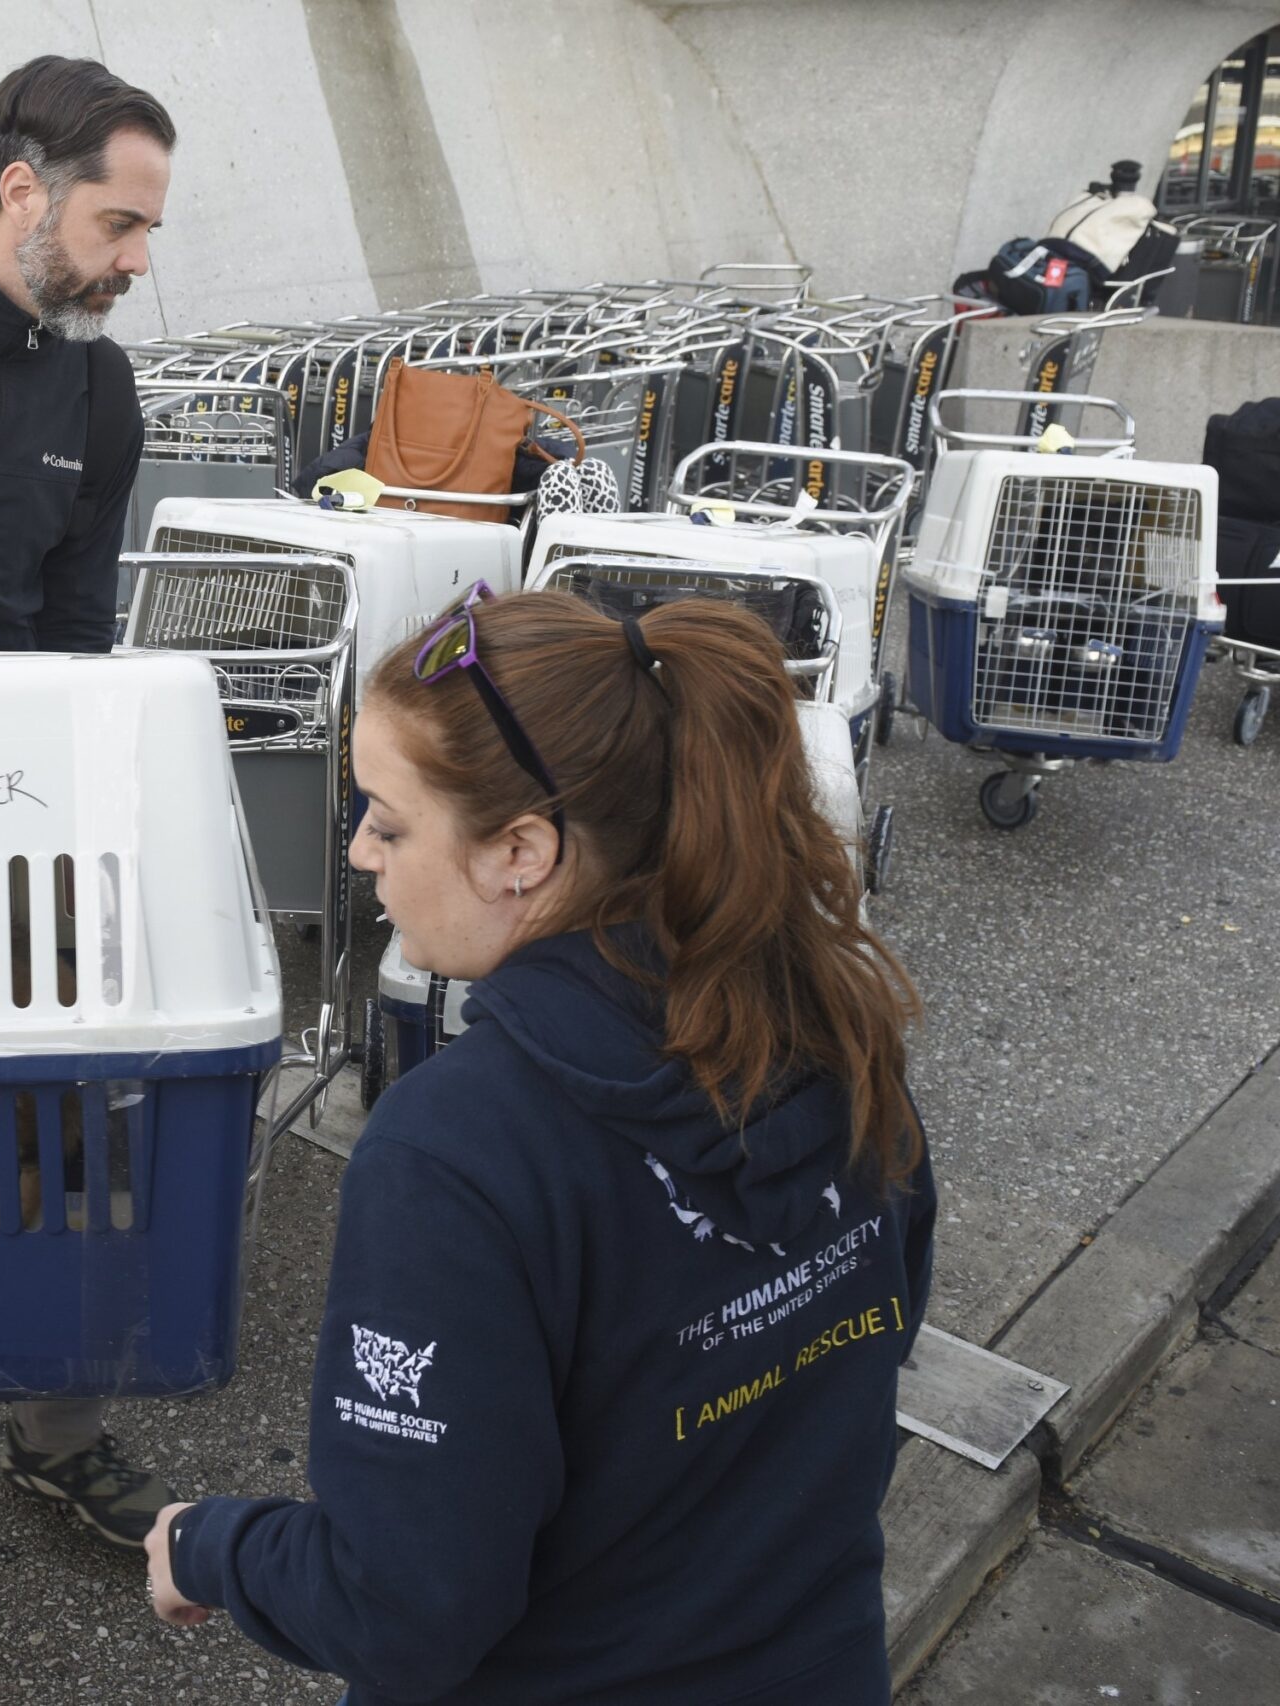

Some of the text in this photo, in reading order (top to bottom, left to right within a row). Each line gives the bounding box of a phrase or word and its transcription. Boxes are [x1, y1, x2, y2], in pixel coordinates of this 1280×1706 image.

[676, 1216, 881, 1346] THE HUMANE SOCIETY
[702, 1256, 858, 1351] OF THE UNITED STATES
[335, 1396, 447, 1434] THE HUMANE SOCIETY
[697, 1364, 787, 1428] ANIMAL
[795, 1307, 886, 1371] RESCUE
[340, 1411, 438, 1444] OF THE UNITED STATES
